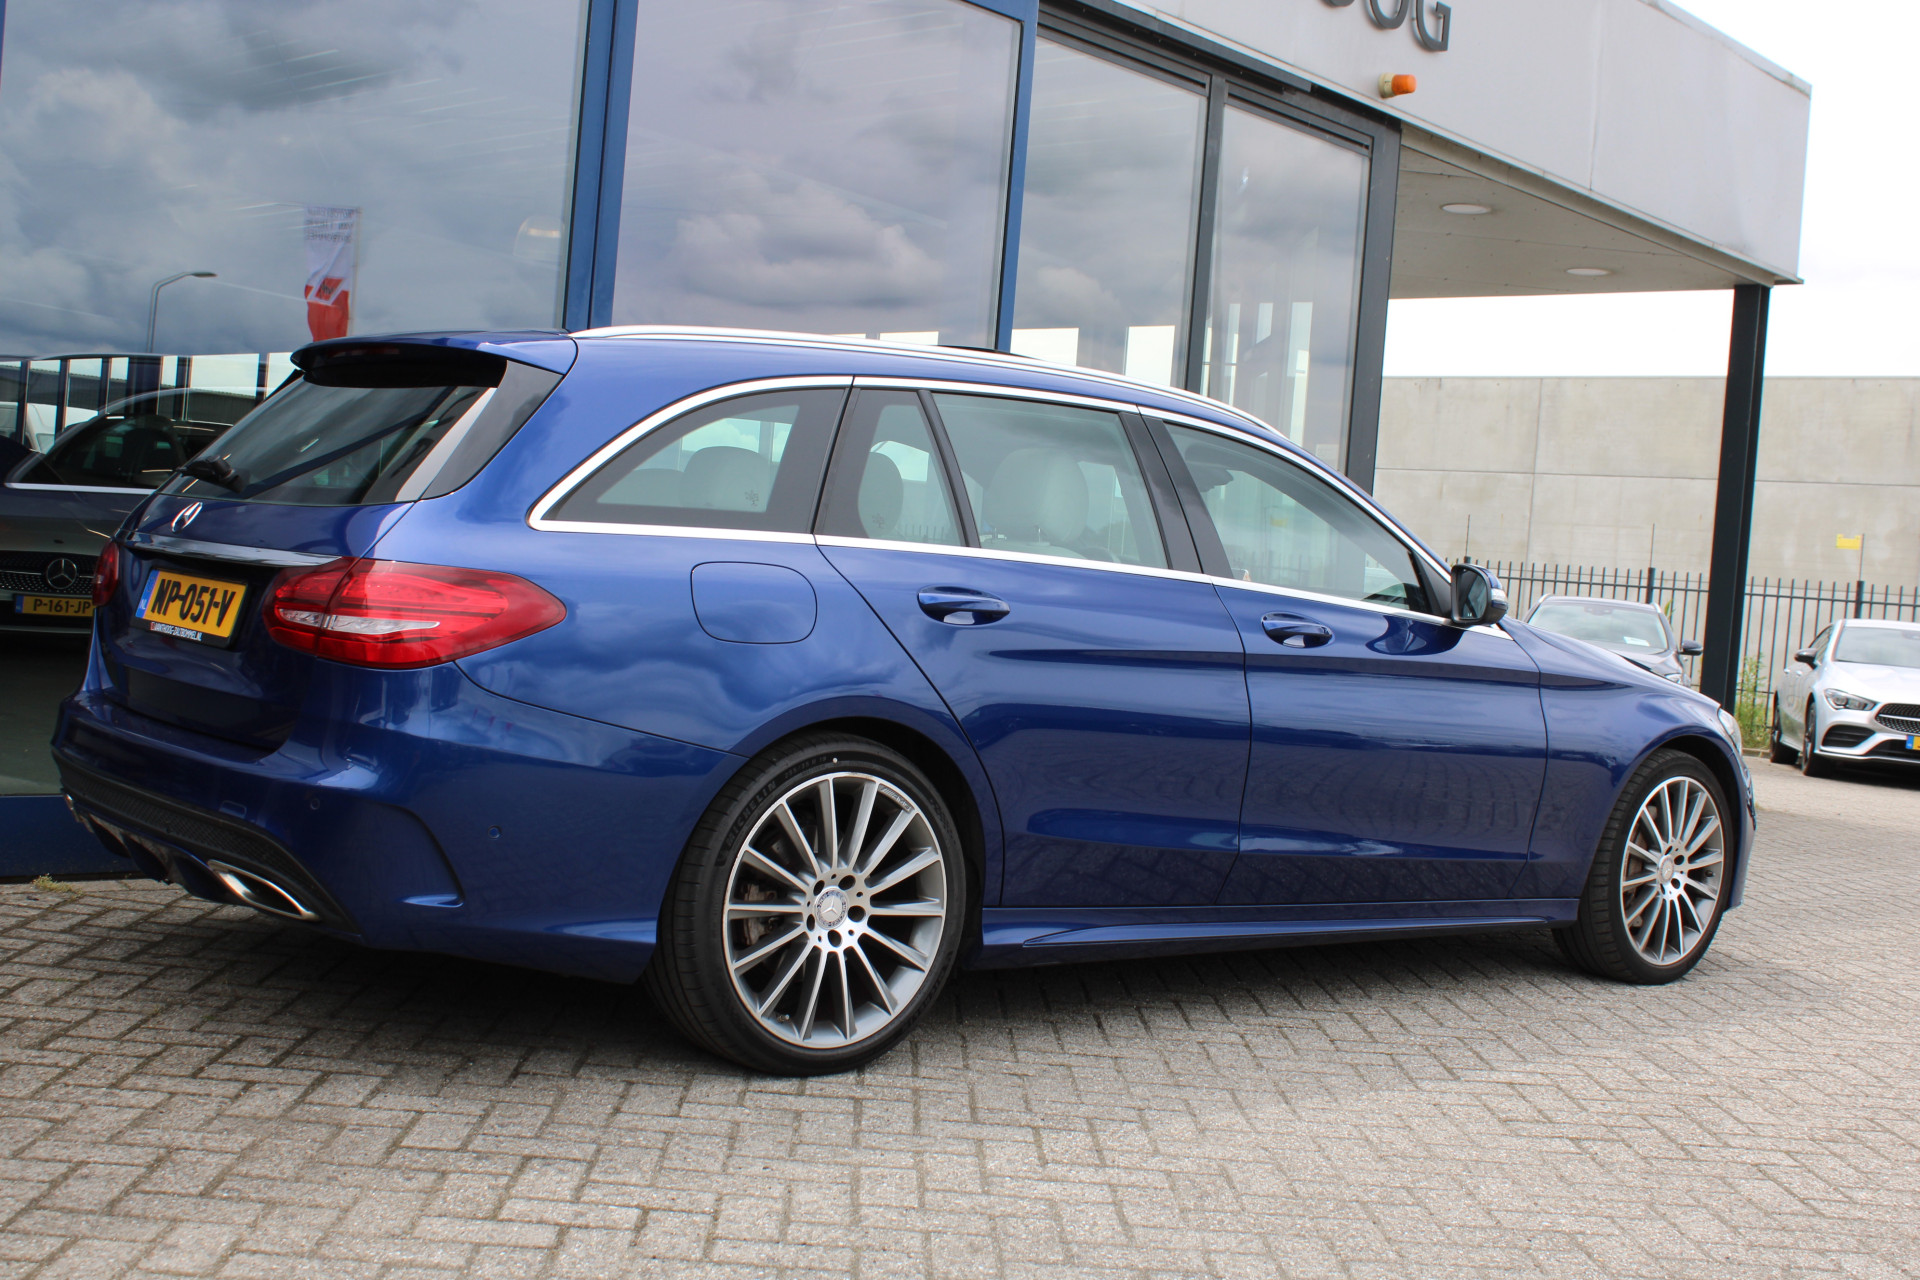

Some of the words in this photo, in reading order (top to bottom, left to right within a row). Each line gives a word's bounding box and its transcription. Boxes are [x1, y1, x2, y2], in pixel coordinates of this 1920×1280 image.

[33, 598, 91, 614] P-161-JP
[151, 579, 236, 628] NP-051-V
[725, 780, 777, 847] MICHELIN
